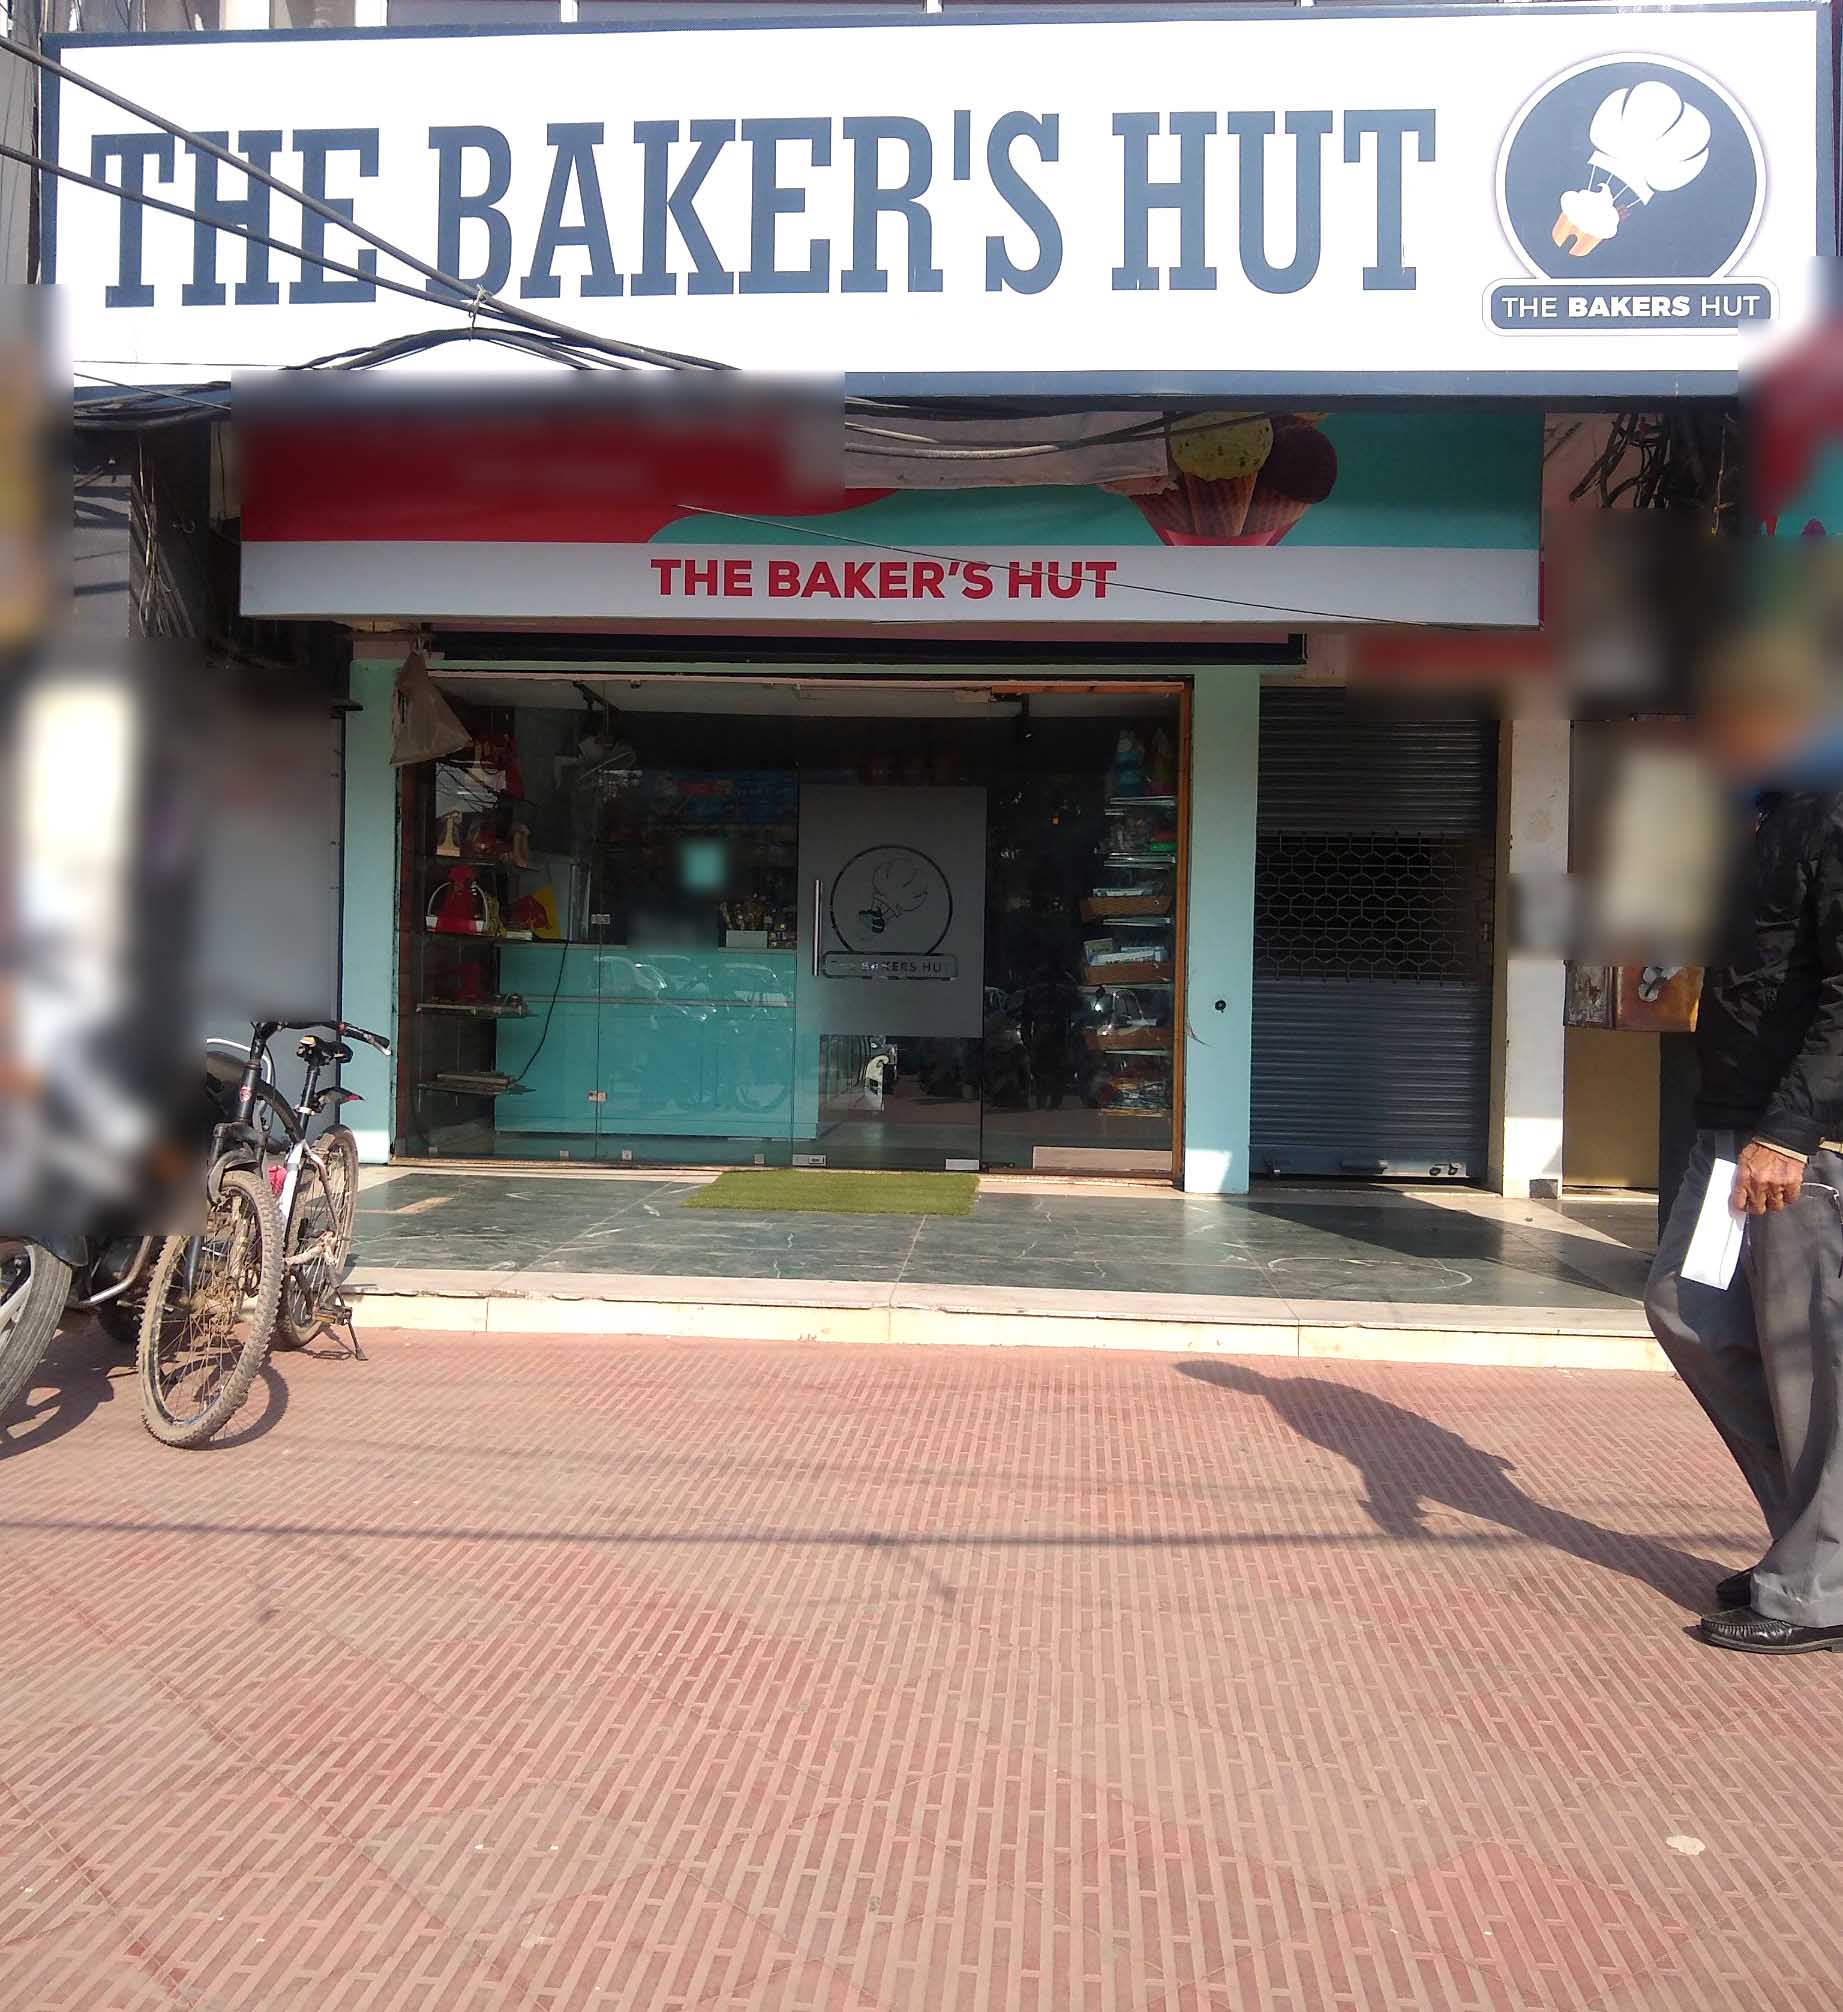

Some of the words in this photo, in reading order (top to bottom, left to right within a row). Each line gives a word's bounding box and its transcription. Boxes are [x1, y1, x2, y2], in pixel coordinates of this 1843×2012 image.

[91, 128, 380, 308] THE
[424, 110, 1064, 300] BAKER'S
[1112, 109, 1437, 294] HUT
[1501, 297, 1558, 317] THE
[1568, 296, 1691, 318] BAKERS
[1701, 295, 1760, 317] HUT
[650, 559, 753, 596] THE
[768, 560, 993, 599] BAKER'S
[1007, 560, 1118, 599] HUT
